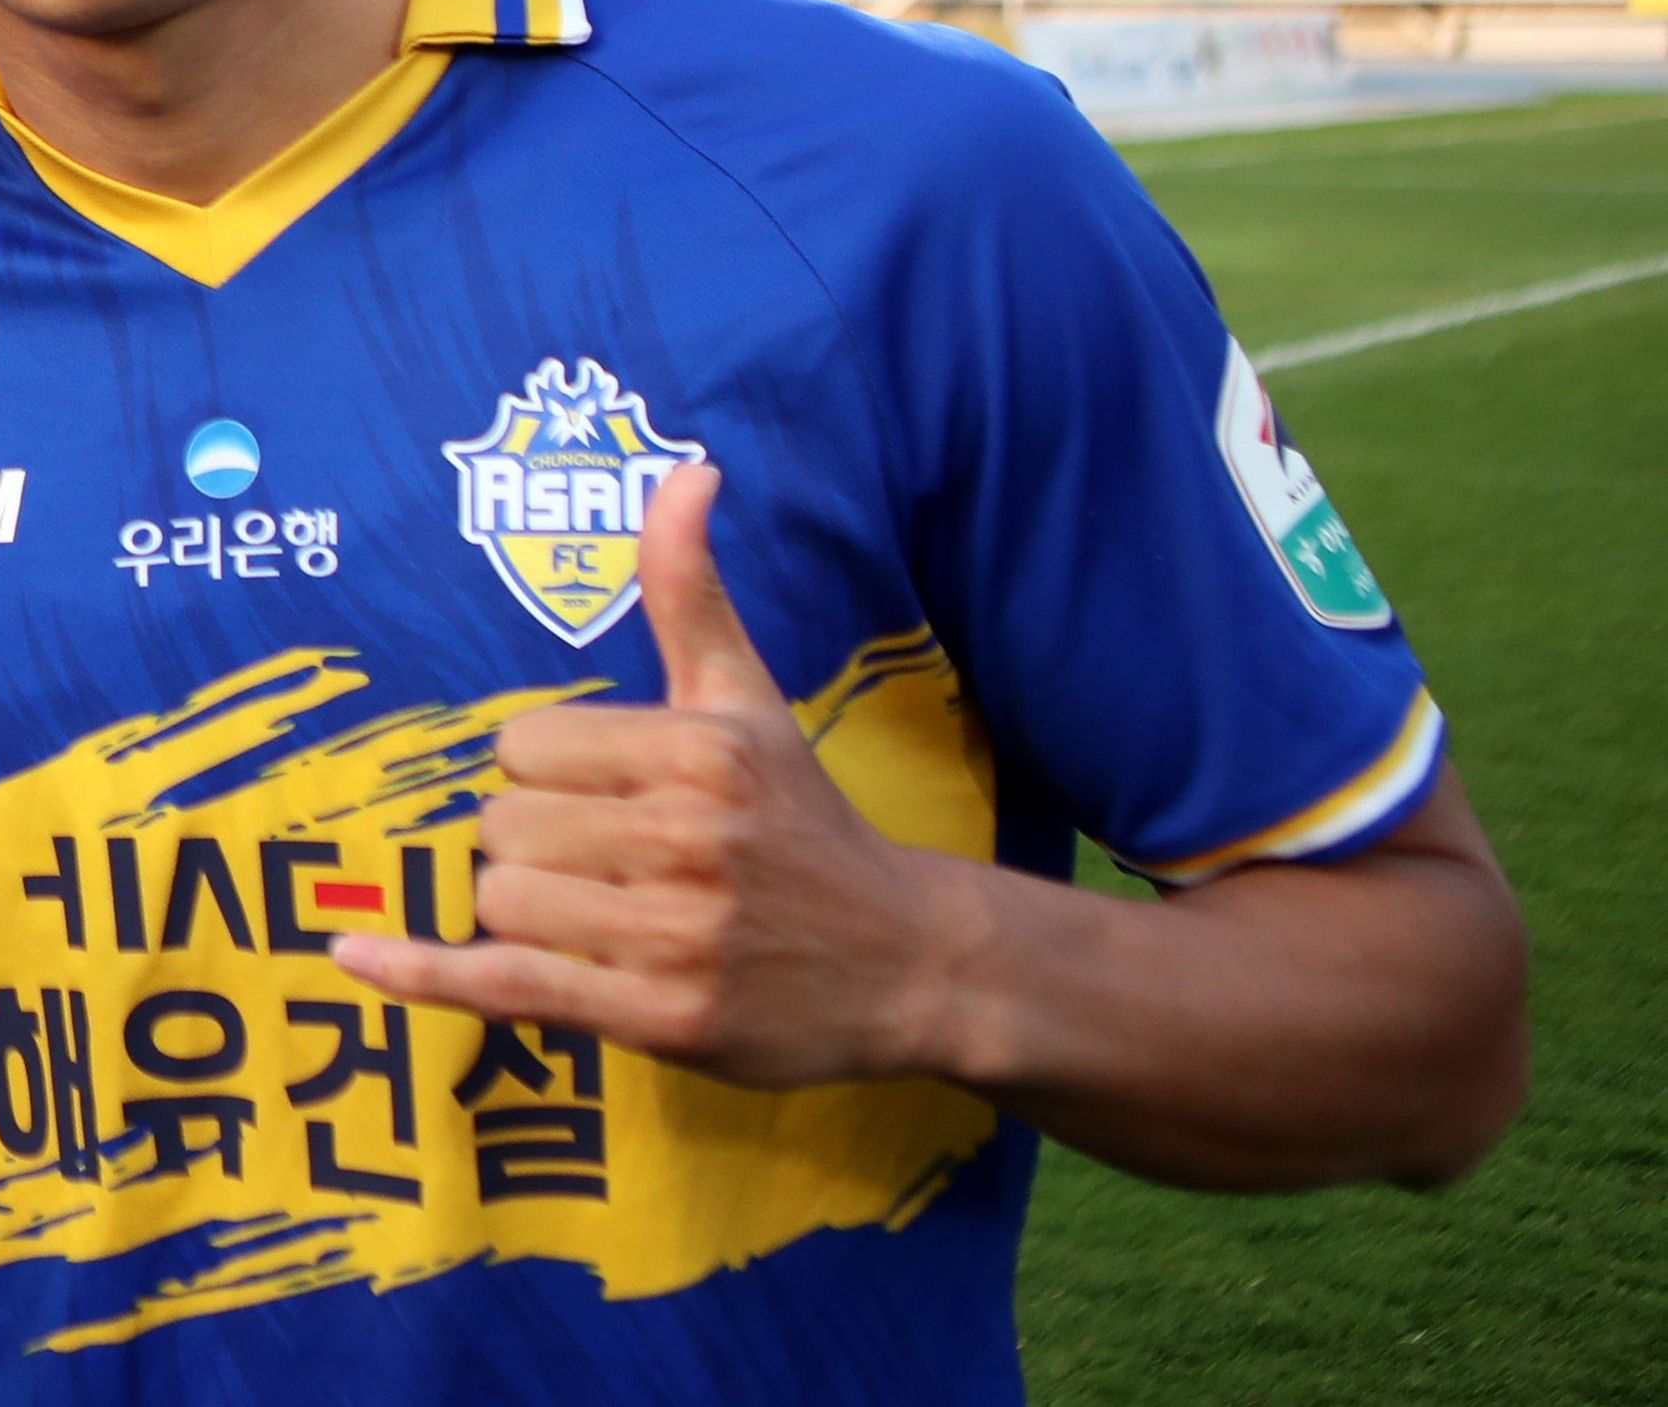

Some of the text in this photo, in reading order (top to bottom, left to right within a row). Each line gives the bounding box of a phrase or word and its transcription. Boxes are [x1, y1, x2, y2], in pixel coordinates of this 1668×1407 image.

[527, 452, 622, 471] CHUNGNAM
[114, 508, 338, 588] 우리은행
[552, 543, 600, 574] FC
